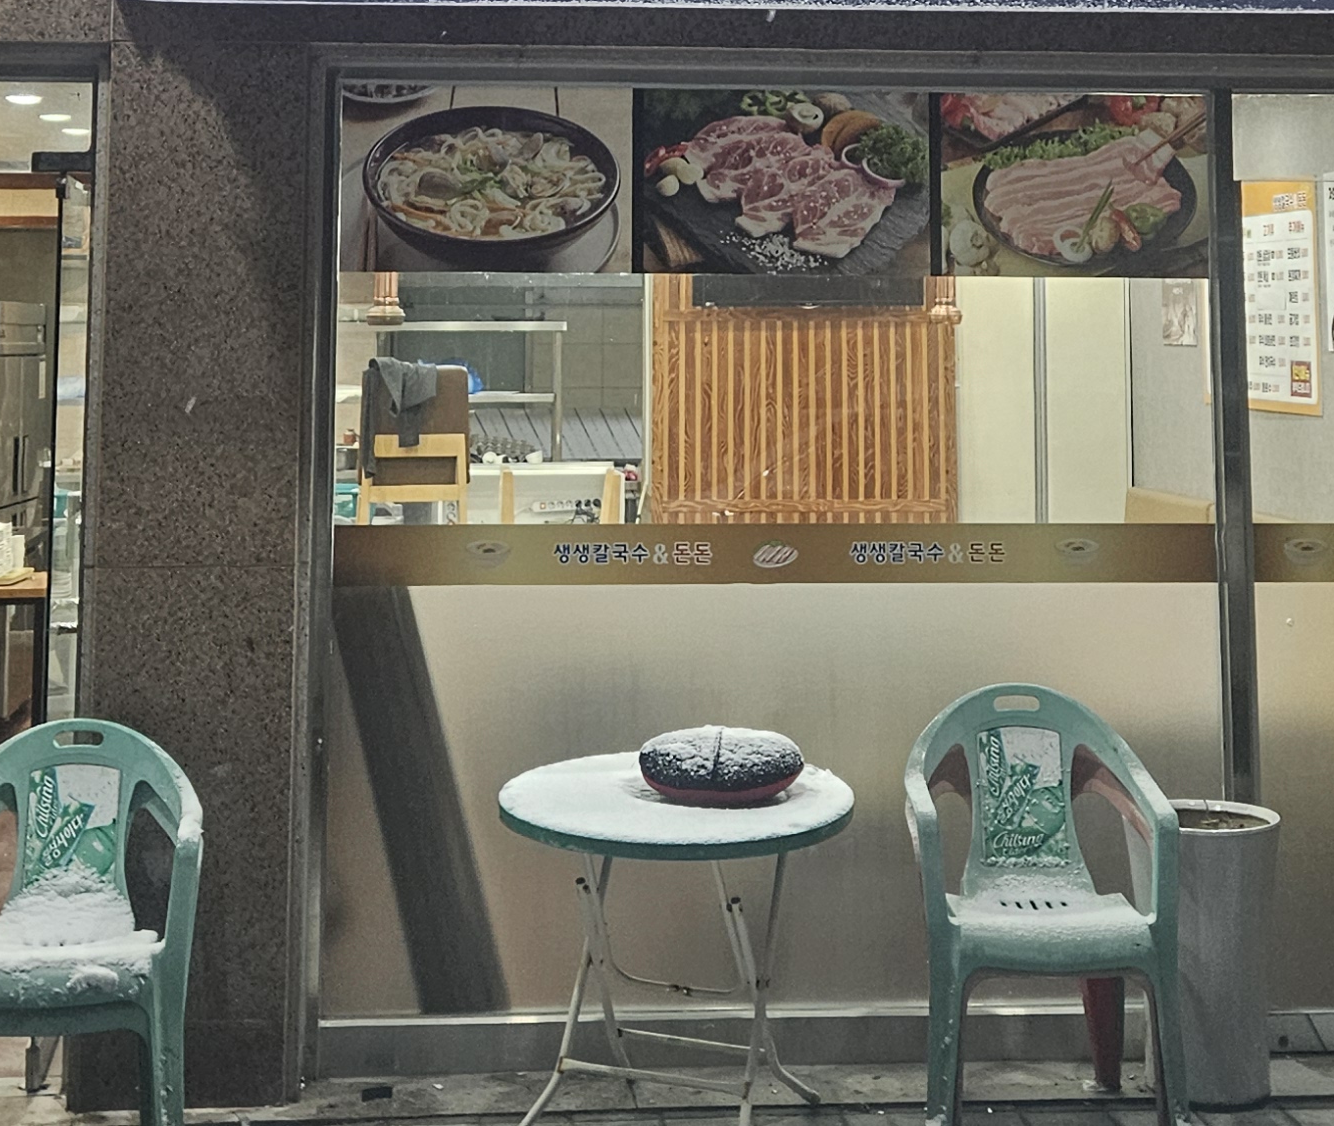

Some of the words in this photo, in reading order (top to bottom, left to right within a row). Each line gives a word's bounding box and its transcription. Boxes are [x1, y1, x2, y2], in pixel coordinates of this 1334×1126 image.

[552, 541, 651, 566] 생생칼국수
[652, 542, 671, 566] &
[671, 541, 714, 566] 돈돈
[849, 540, 945, 565] 생생칼국수
[946, 541, 964, 565] &
[965, 540, 1008, 565] 돈돈
